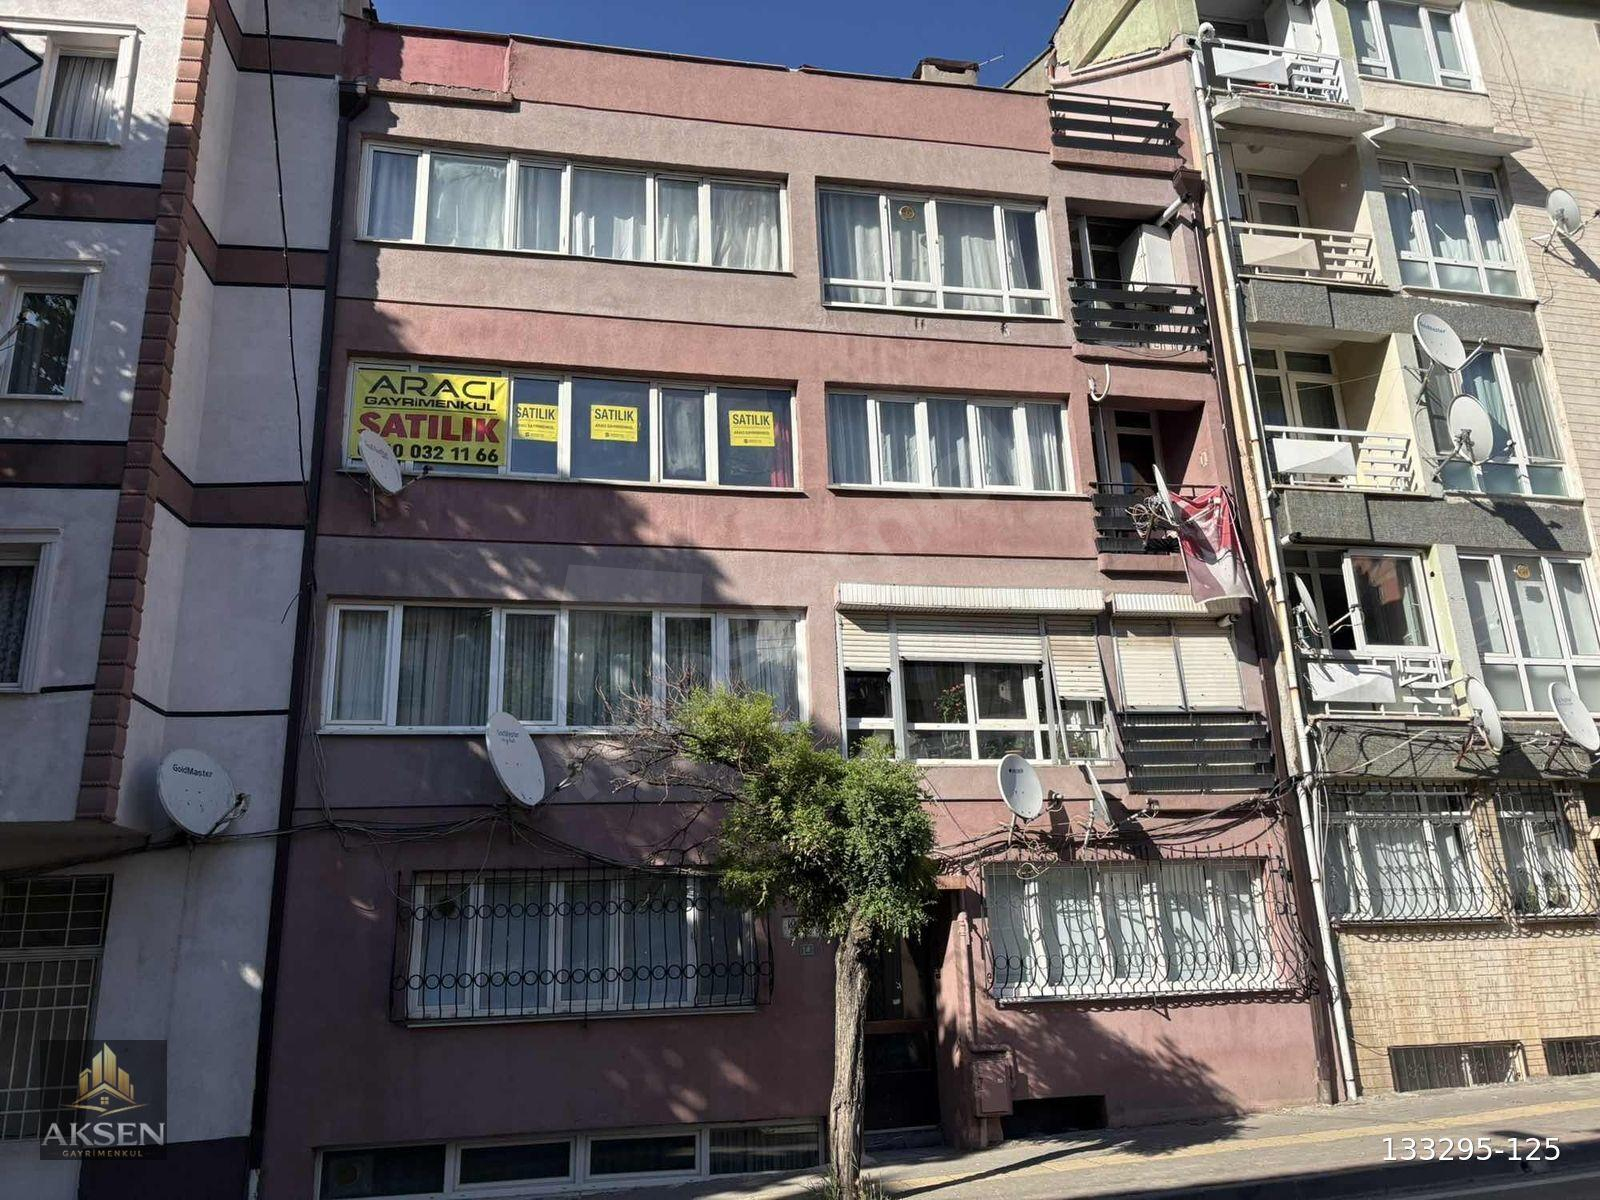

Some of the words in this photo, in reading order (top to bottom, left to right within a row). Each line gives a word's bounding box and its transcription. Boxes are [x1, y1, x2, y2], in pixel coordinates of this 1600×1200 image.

[368, 375, 495, 400] ARACI
[364, 396, 497, 412] GAYRİMENKUL
[516, 407, 556, 420] SATILIK
[594, 408, 634, 422] SATILIK
[732, 413, 770, 426] SATILIK
[358, 412, 500, 443] SATILIK
[410, 444, 443, 460] 032
[451, 447, 469, 460] 11
[476, 449, 498, 462] 66
[172, 763, 213, 777] GoldMaster
